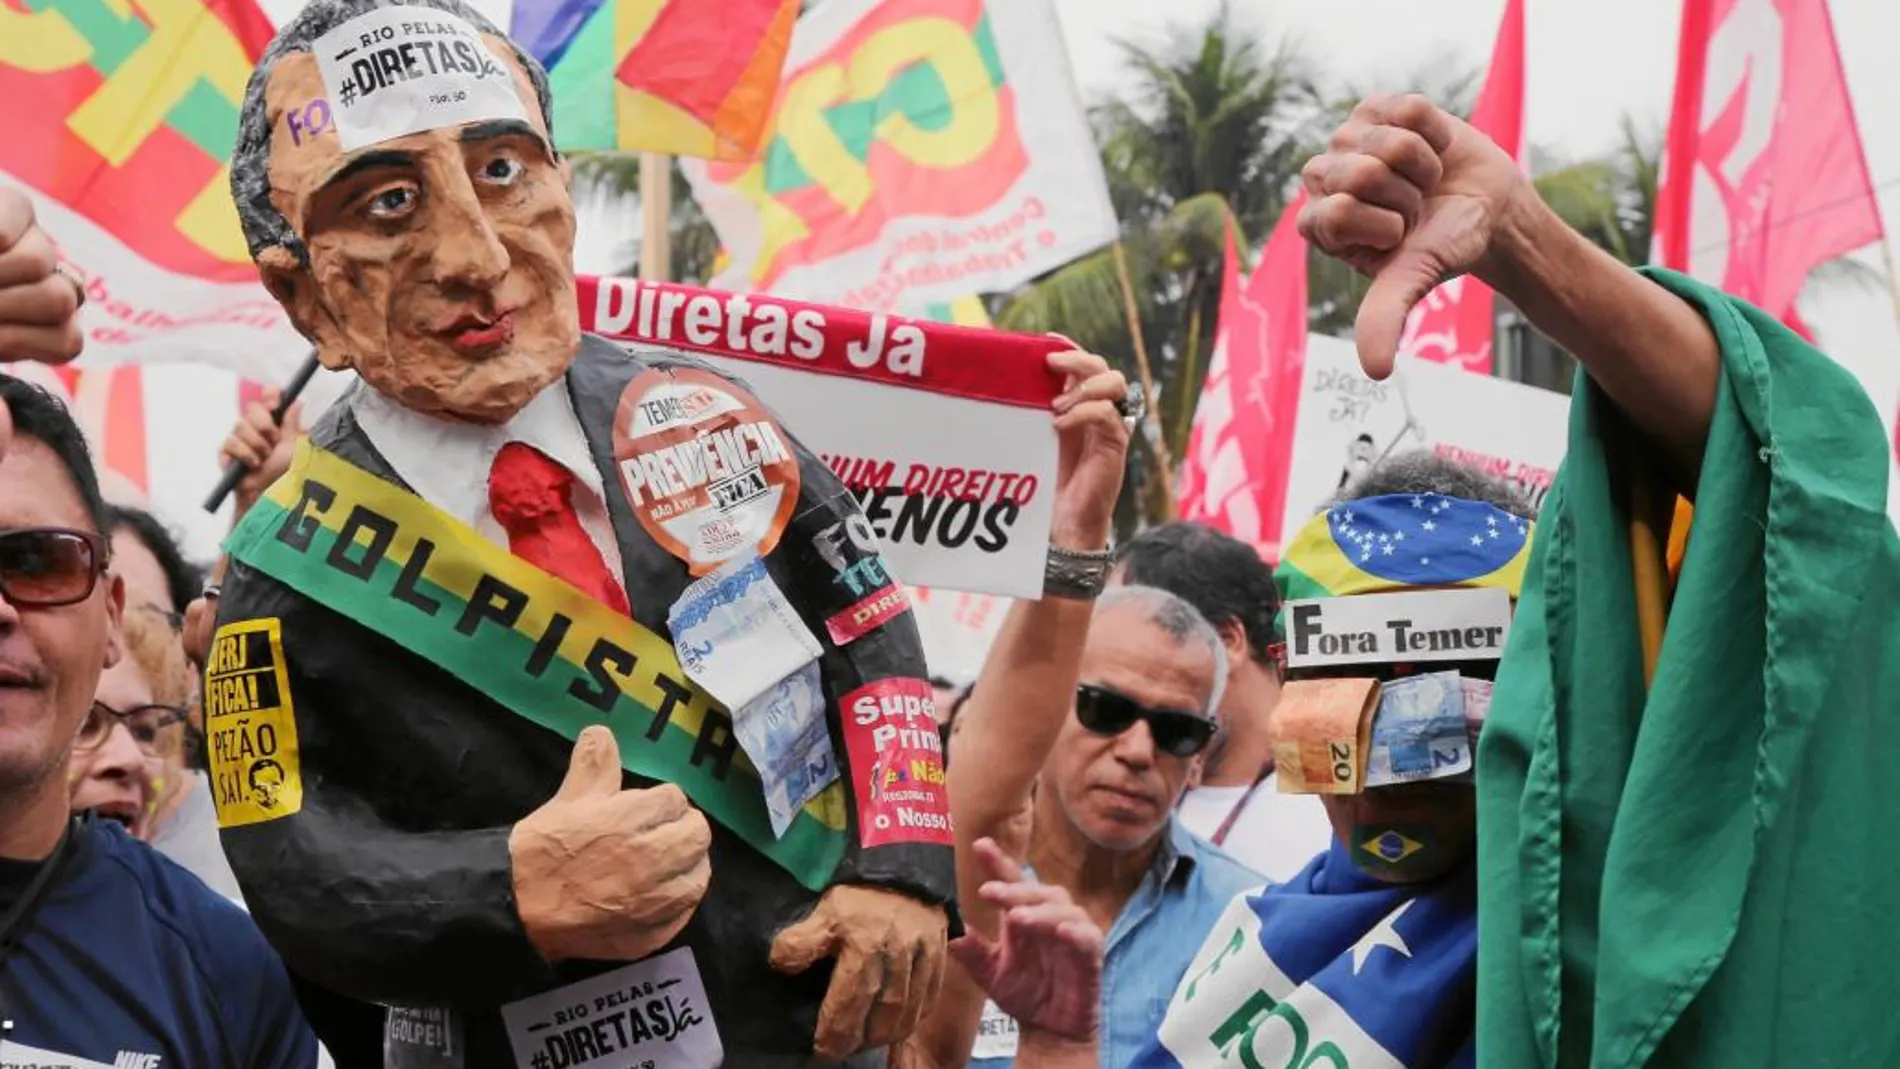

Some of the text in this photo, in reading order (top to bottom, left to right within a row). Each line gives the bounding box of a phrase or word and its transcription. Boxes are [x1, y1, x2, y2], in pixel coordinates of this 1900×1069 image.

[360, 21, 458, 48] RIO PELAS
[594, 276, 826, 361] Diretas
[846, 312, 926, 377] Já
[709, 473, 766, 508] FICA
[904, 464, 1038, 507] DIREITO
[274, 477, 736, 781] GOLPISTA
[1293, 604, 1503, 655] Fora Temer
[679, 640, 706, 675] REAIS
[211, 672, 260, 717] FICA!
[214, 718, 278, 765] PEZÃO
[872, 723, 943, 754] Prim
[1431, 748, 1461, 768] 2
[1330, 743, 1352, 782] 20
[896, 806, 947, 830] Nosso
[554, 981, 654, 1025] RIO PELAS
[114, 1049, 162, 1069] NIKE
